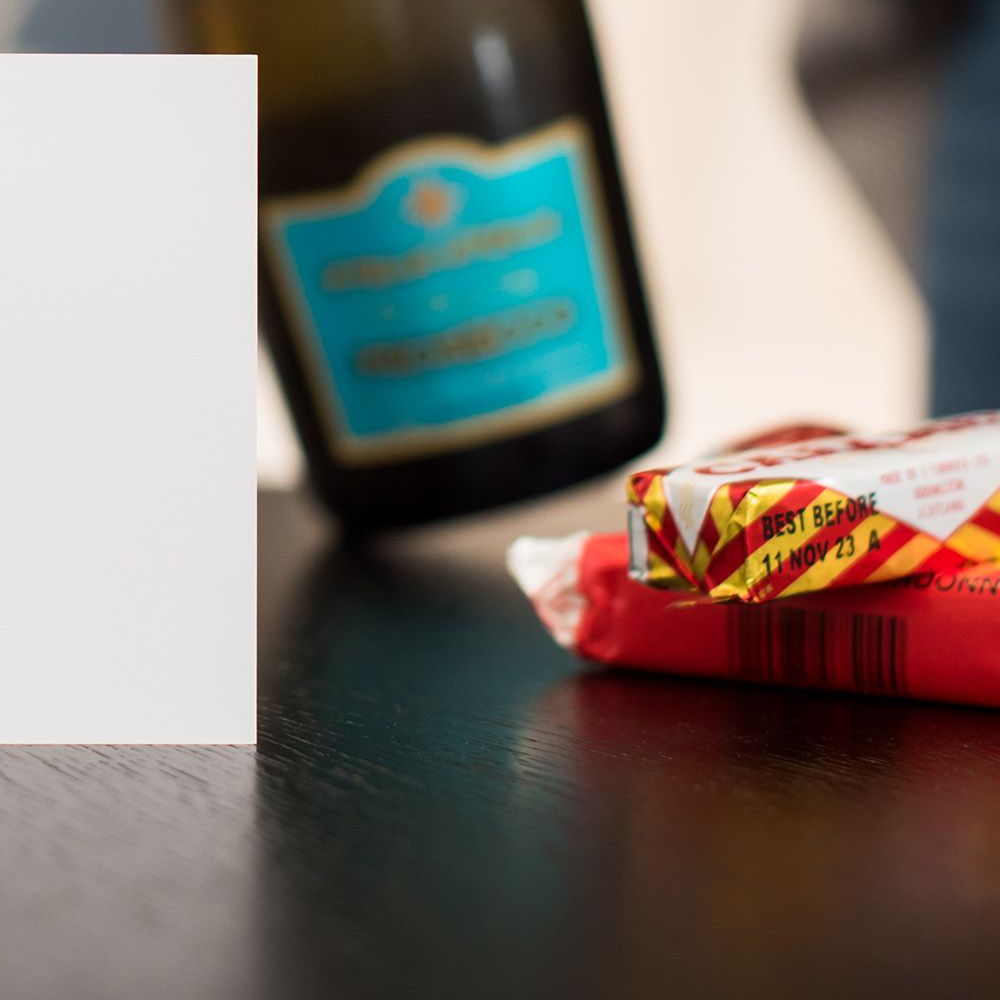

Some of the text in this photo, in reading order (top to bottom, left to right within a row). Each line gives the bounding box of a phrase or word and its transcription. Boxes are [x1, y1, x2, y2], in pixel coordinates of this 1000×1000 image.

[761, 508, 805, 540] BEST
[812, 492, 879, 529] BEFORE
[762, 528, 881, 575] 11 NOV 23 A
